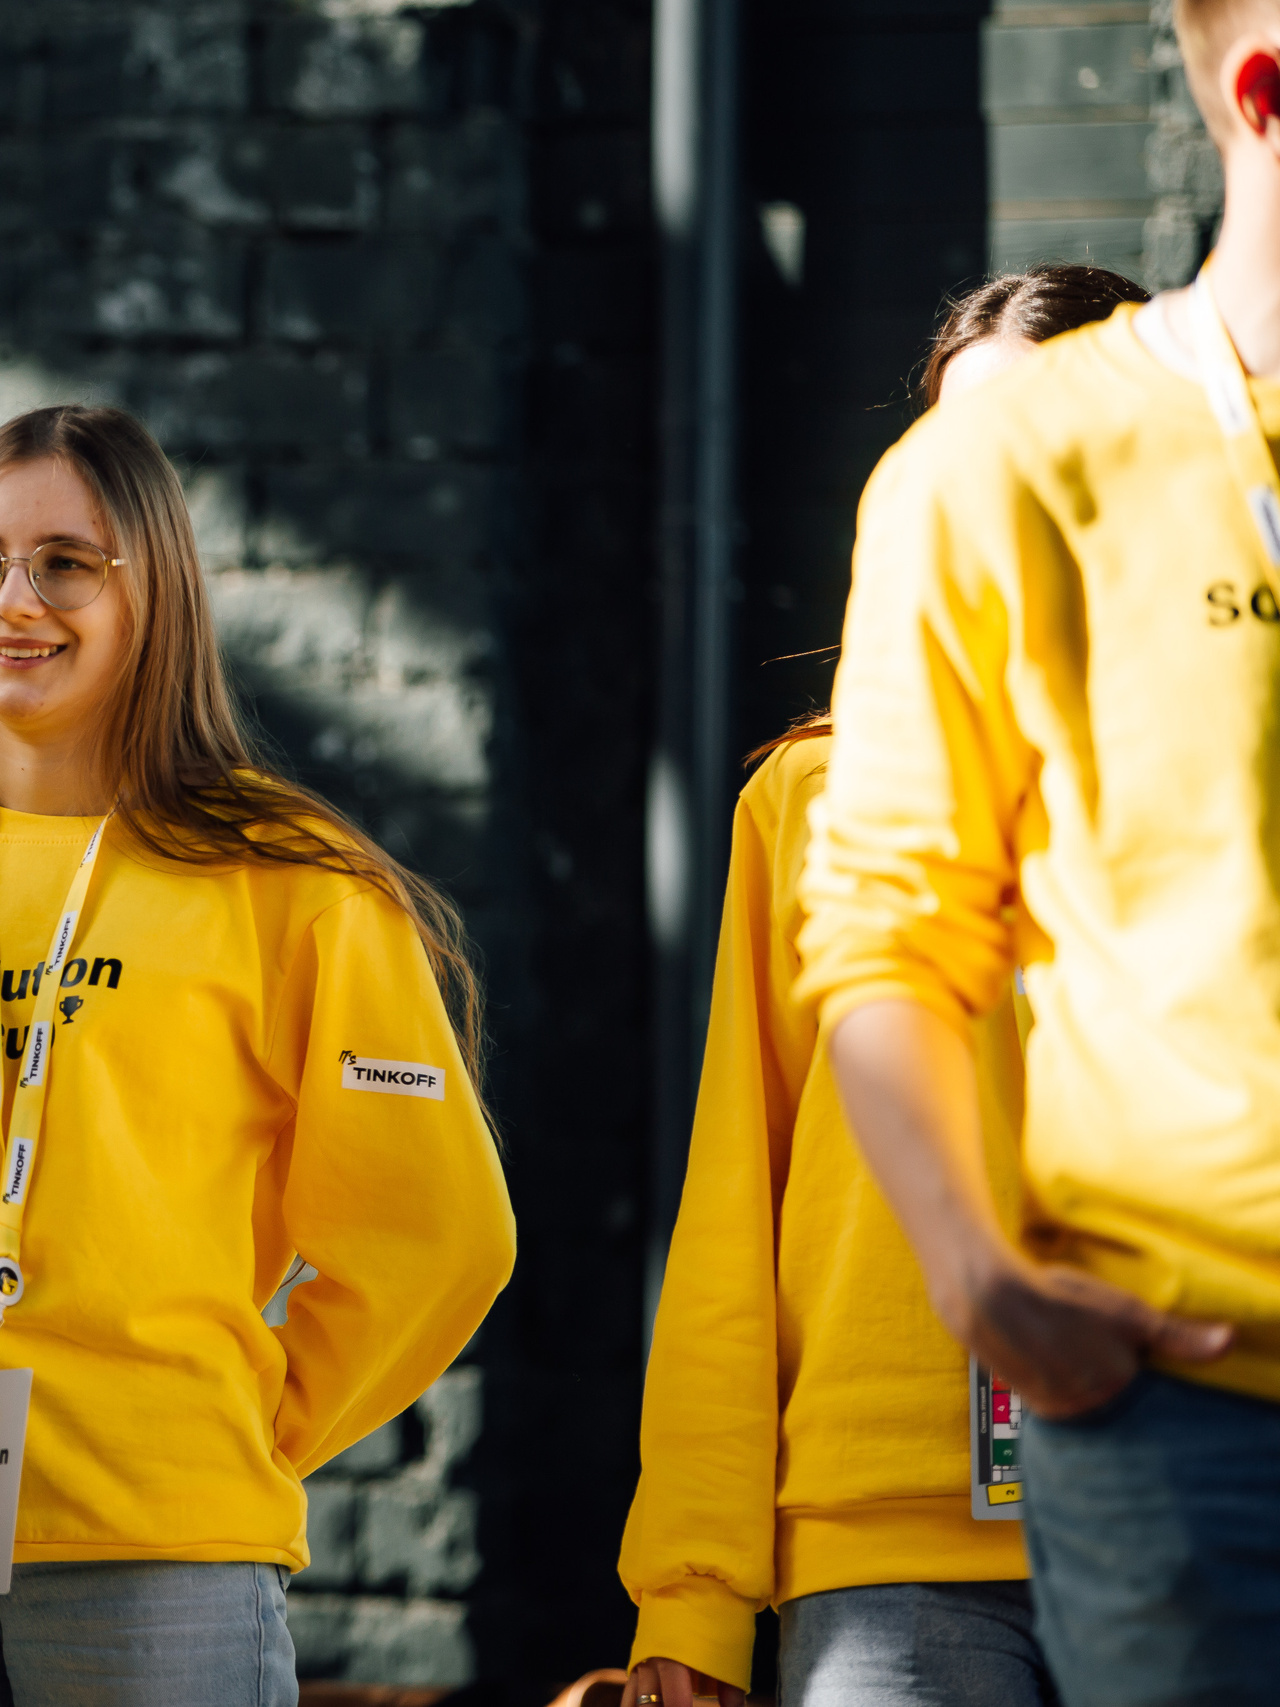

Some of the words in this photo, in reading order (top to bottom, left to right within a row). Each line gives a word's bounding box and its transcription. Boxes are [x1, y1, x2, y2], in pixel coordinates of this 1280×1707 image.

[54, 917, 71, 966] TINKOFF
[29, 1027, 44, 1079] TINKOFF
[353, 1067, 436, 1088] TINKOFF
[11, 1143, 26, 1196] TINKOFF
